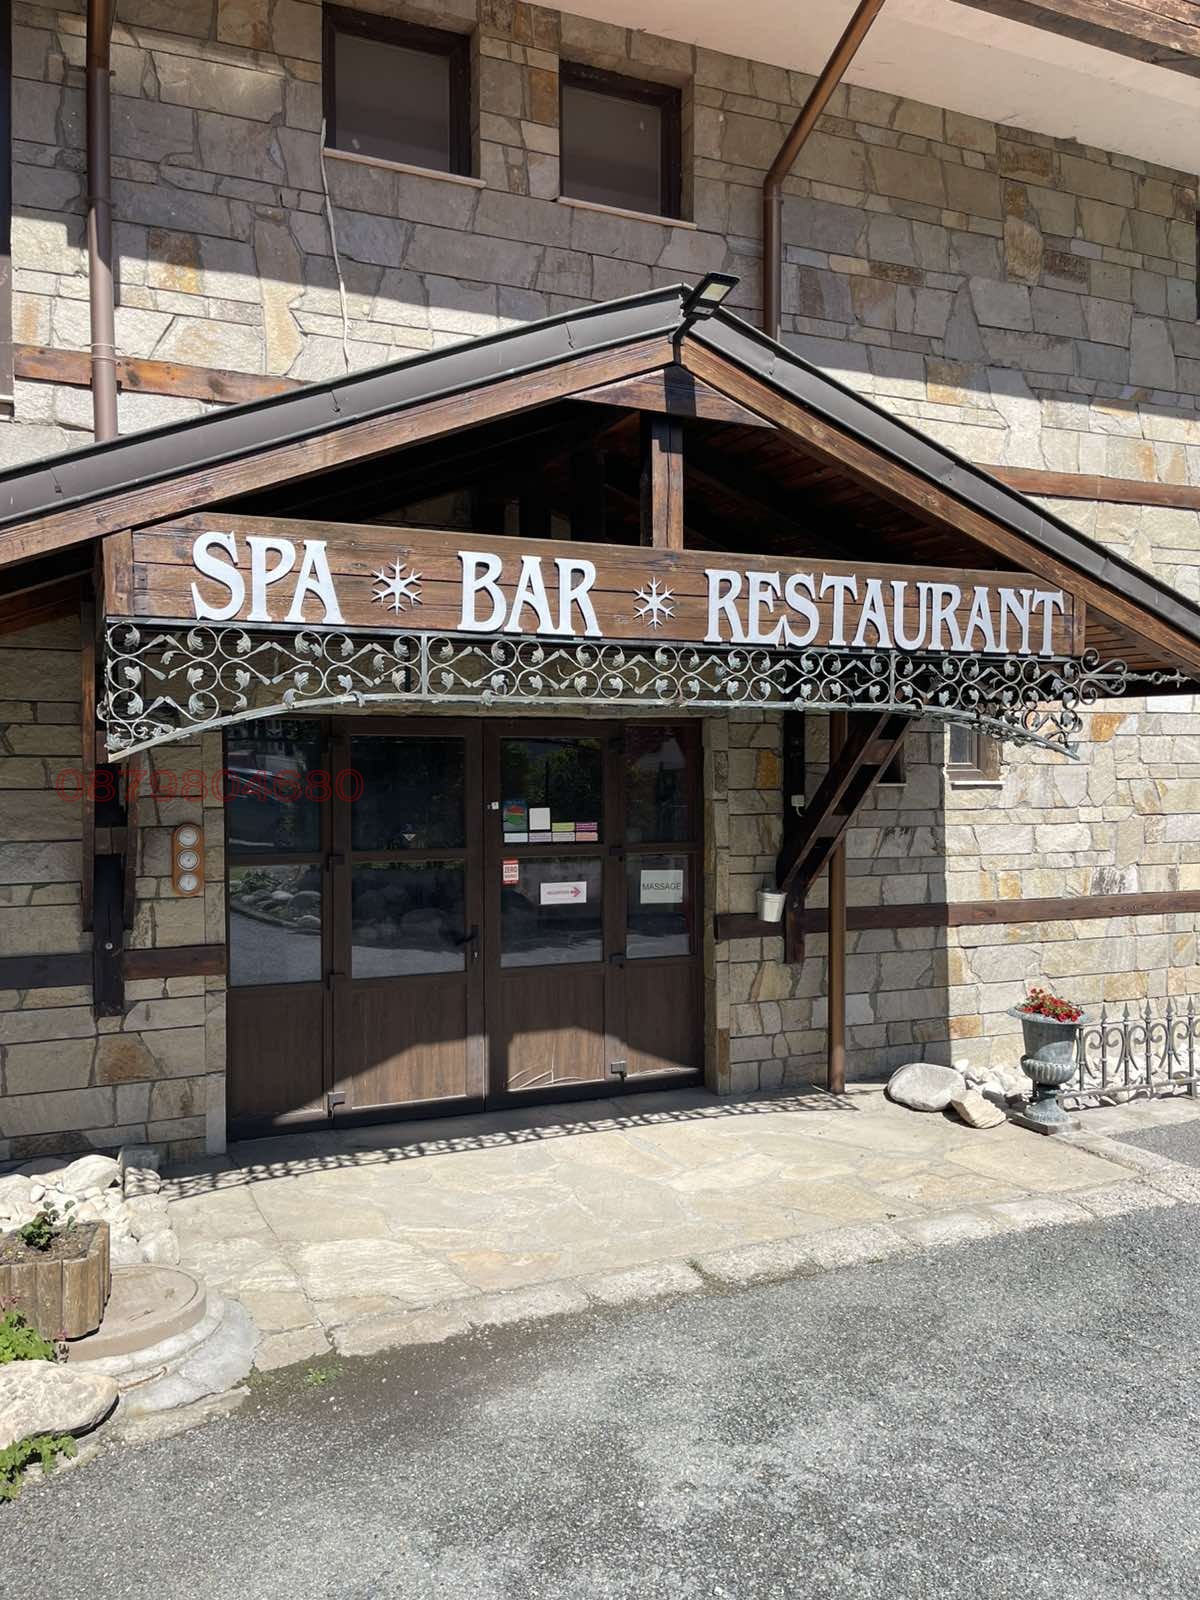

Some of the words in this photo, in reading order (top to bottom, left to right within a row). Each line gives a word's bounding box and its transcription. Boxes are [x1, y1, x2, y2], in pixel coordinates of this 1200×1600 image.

[191, 530, 345, 626] SPA
[457, 551, 603, 638] BAR
[704, 568, 1066, 656] RESTAURANT
[642, 881, 681, 891] MASSAGE
